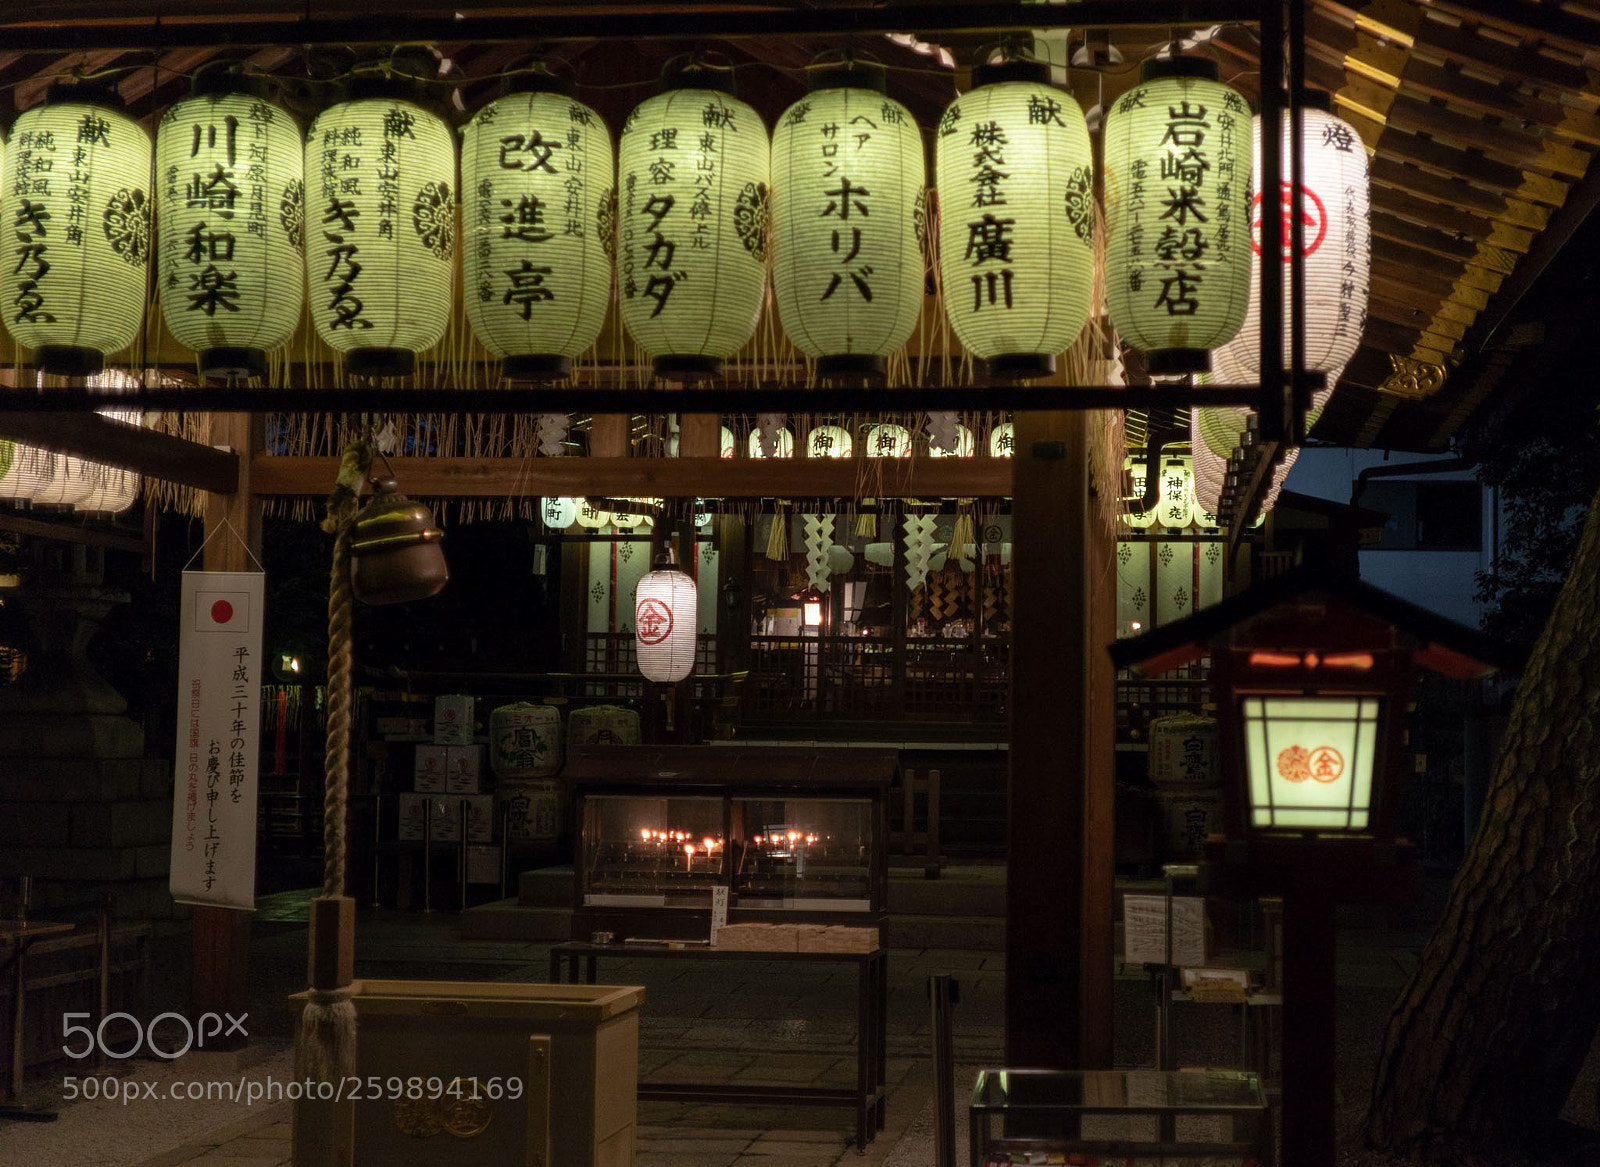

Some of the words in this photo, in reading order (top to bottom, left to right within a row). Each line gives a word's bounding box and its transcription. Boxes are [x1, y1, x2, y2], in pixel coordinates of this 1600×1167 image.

[76, 114, 111, 148] 献
[383, 108, 416, 140] 献
[568, 104, 596, 129] 献
[702, 102, 738, 132] 献
[849, 115, 878, 150] ヘア
[1027, 94, 1067, 128] 献
[1322, 122, 1354, 154] 燈
[32, 130, 56, 197] 純和風
[340, 125, 363, 196] 純和風
[563, 126, 584, 239] 東山安井北
[648, 127, 678, 185] 理容
[821, 122, 840, 177] サロン
[968, 120, 1011, 209] 株式会社
[66, 145, 90, 247] 東山安井角
[183, 114, 243, 317] 川崎和楽
[375, 139, 398, 241] 東山安井角
[499, 129, 562, 321] 改進亭
[641, 194, 688, 319] タカダ
[818, 176, 874, 303] ホリバ
[963, 213, 1016, 313] 廣川
[639, 603, 668, 637] 金
[229, 646, 250, 803] 平成三十年の佳節を
[1313, 751, 1339, 777] 金
[203, 739, 220, 892] お慶び申し上げます
